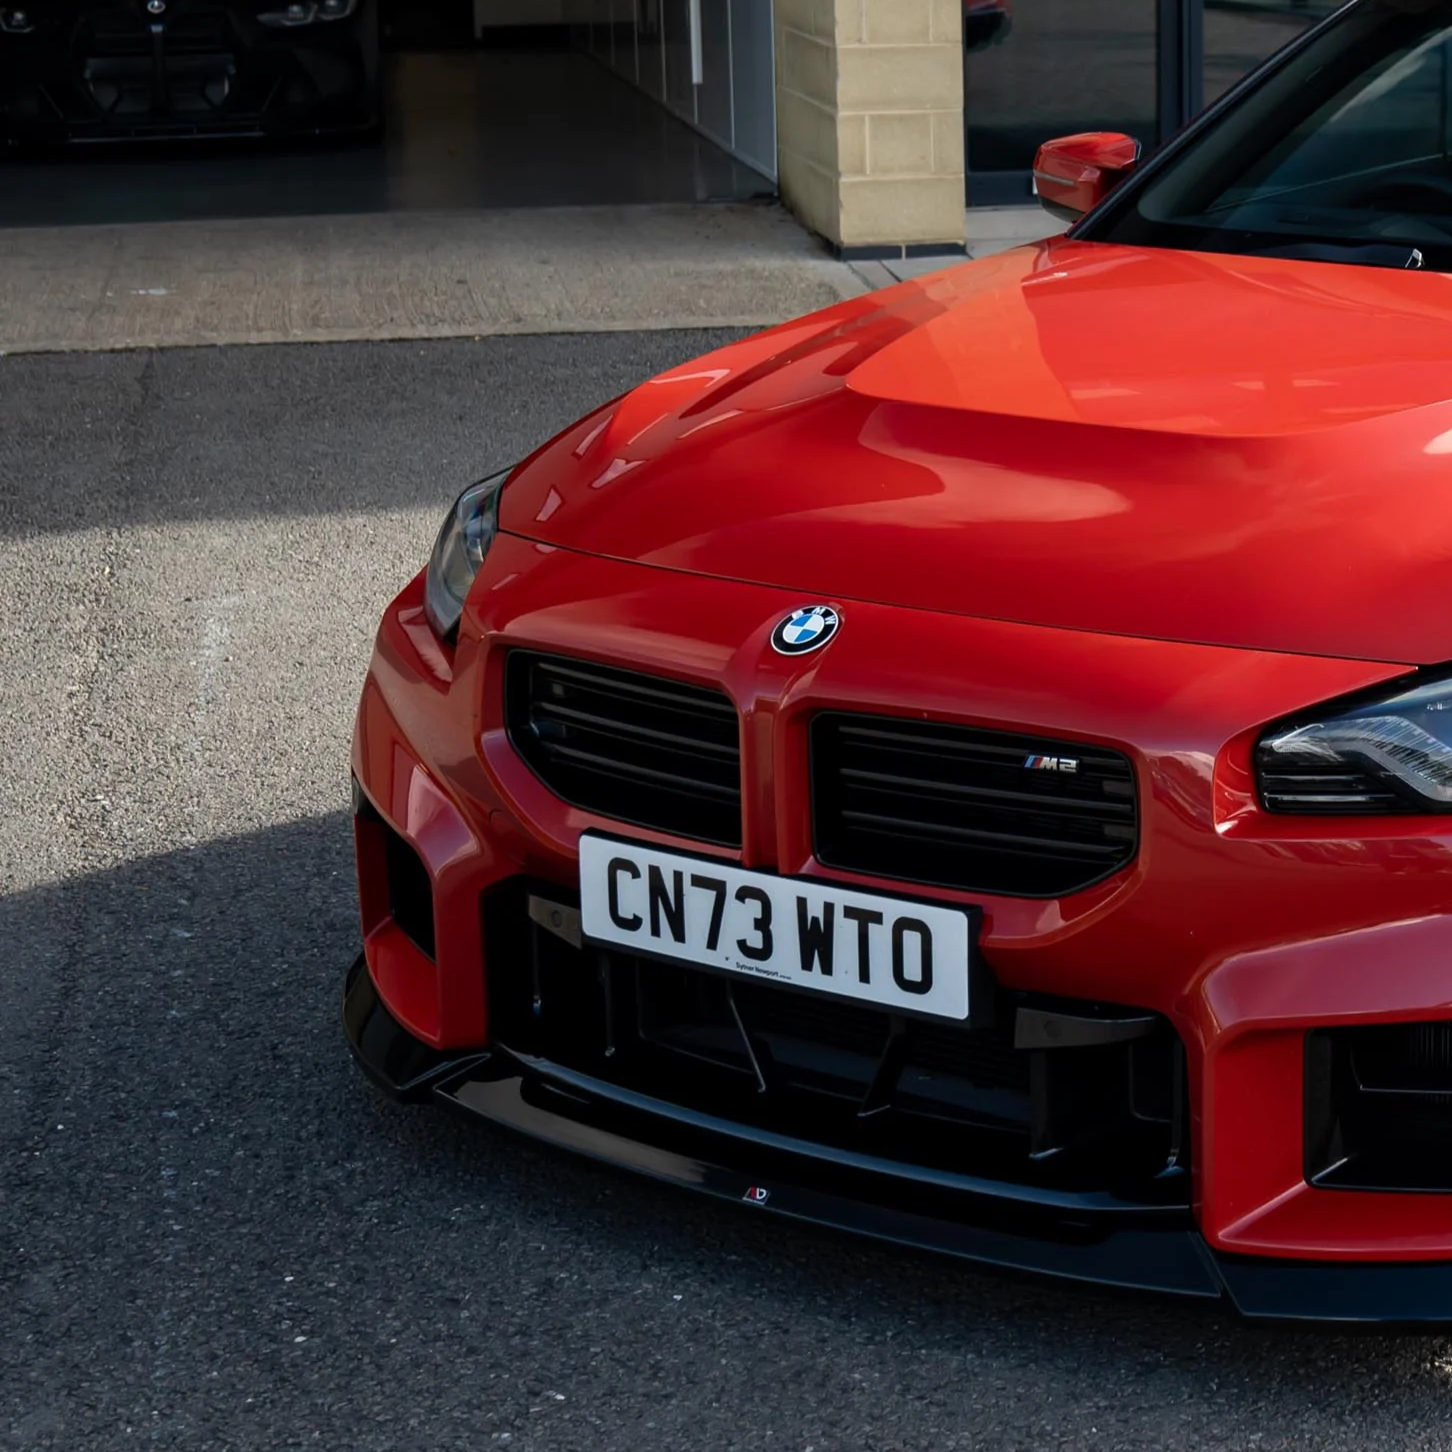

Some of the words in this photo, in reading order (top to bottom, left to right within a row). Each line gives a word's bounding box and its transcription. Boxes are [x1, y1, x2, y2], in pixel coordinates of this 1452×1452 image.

[1040, 755, 1078, 773] M2
[607, 857, 773, 961] CN73
[796, 895, 933, 995] WTO
